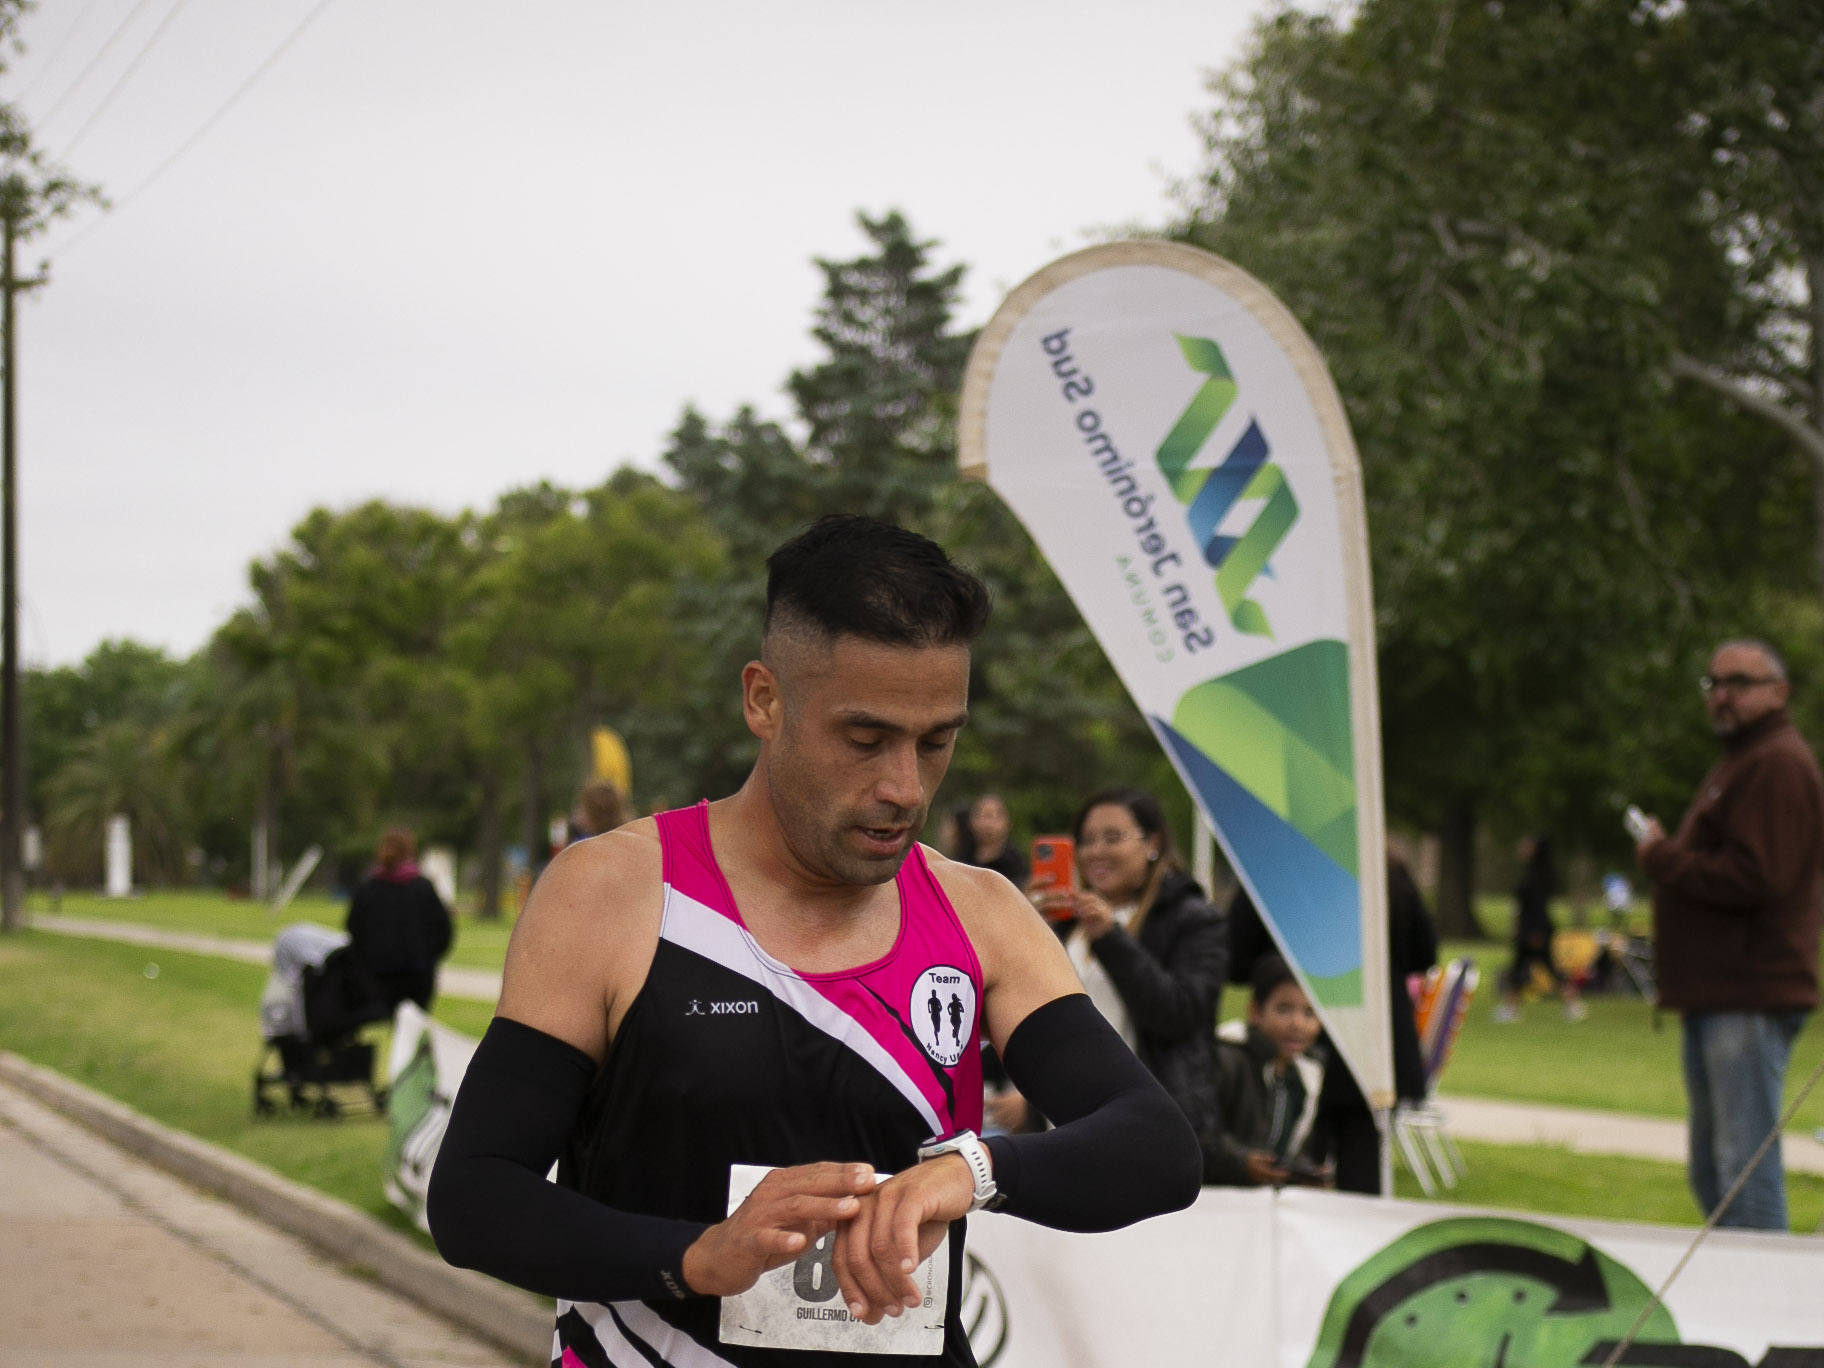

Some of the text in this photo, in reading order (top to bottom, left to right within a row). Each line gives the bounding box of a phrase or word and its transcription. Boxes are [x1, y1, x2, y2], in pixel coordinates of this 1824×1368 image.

[928, 973, 960, 984] Team
[926, 1043, 948, 1065] Nancy
[796, 1307, 848, 1322] GUILLERMO
